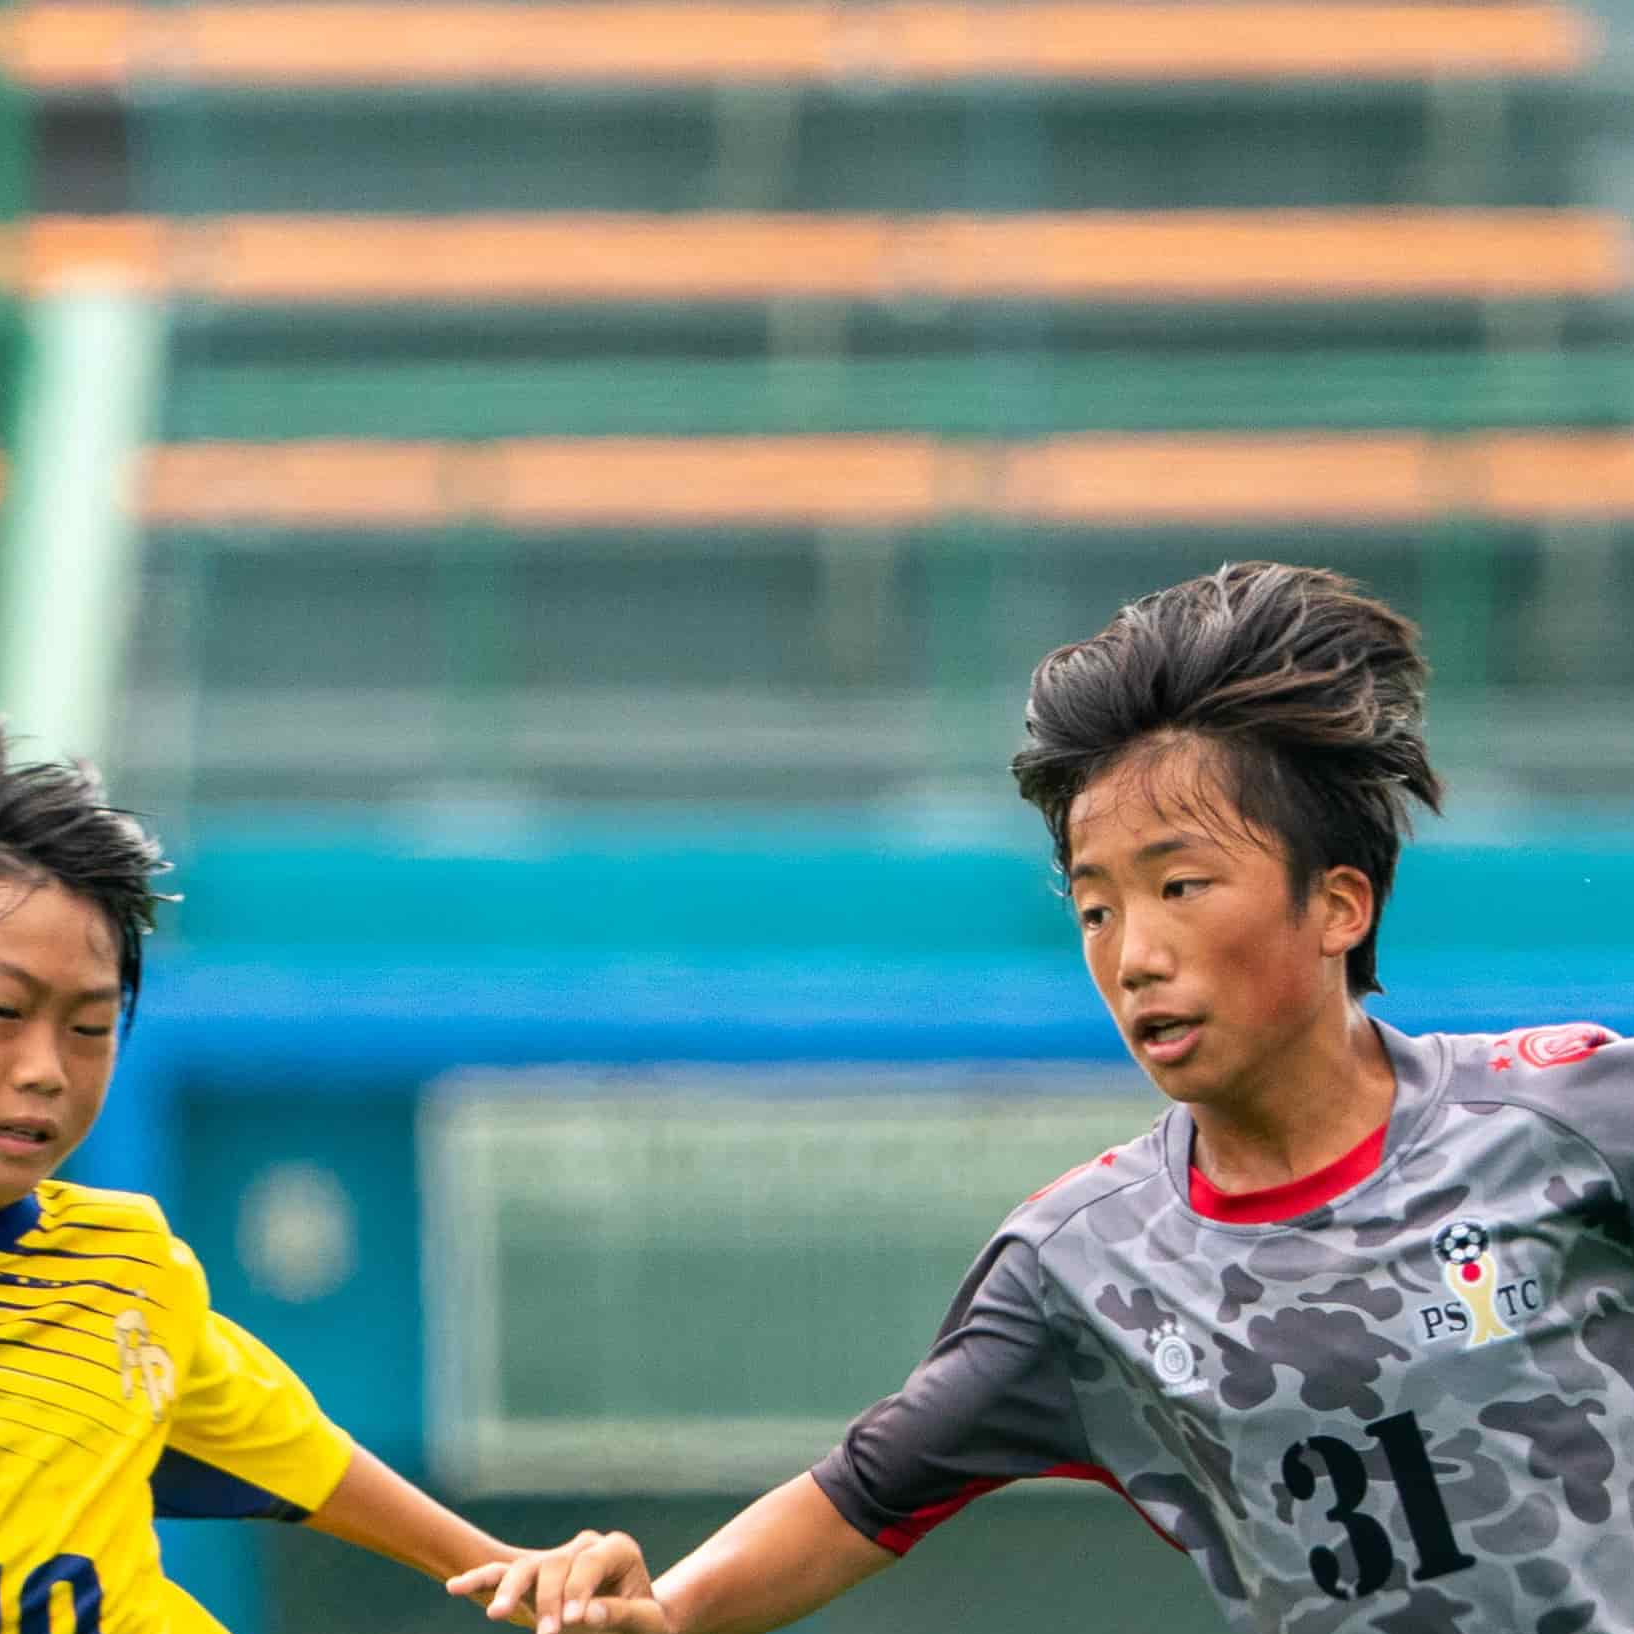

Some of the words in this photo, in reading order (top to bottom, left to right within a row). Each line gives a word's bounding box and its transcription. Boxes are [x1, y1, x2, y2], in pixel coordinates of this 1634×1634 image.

[1420, 1301, 1468, 1339] PS
[1497, 1279, 1538, 1316] TC
[1282, 1410, 1476, 1600] 31
